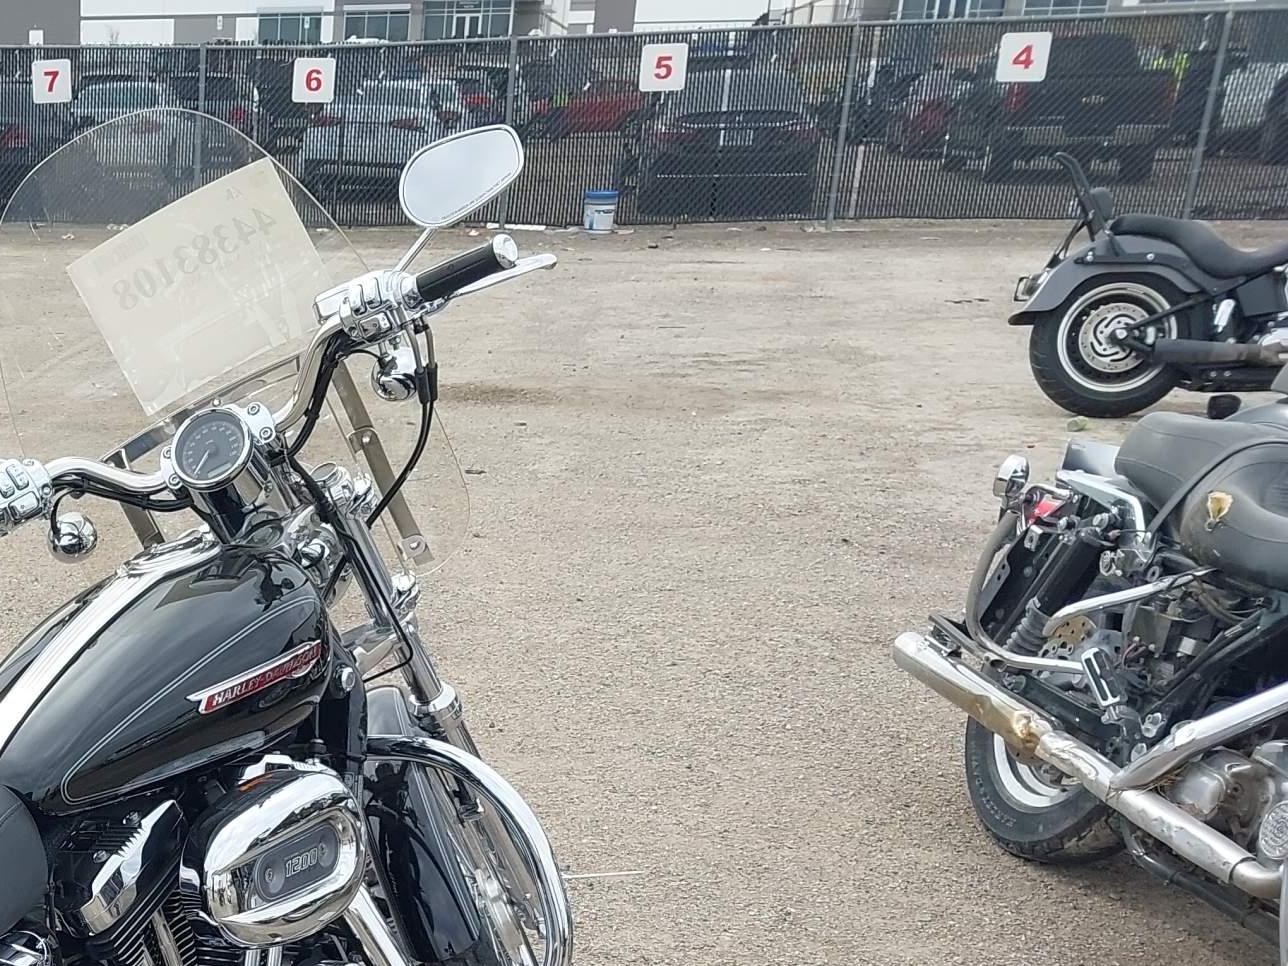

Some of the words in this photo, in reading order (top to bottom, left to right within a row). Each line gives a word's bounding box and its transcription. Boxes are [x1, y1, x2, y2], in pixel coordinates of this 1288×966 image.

[654, 54, 674, 79] 5
[1011, 45, 1034, 69] 4
[42, 69, 60, 92] 7
[304, 68, 324, 91] 6
[285, 848, 318, 878] 1200
